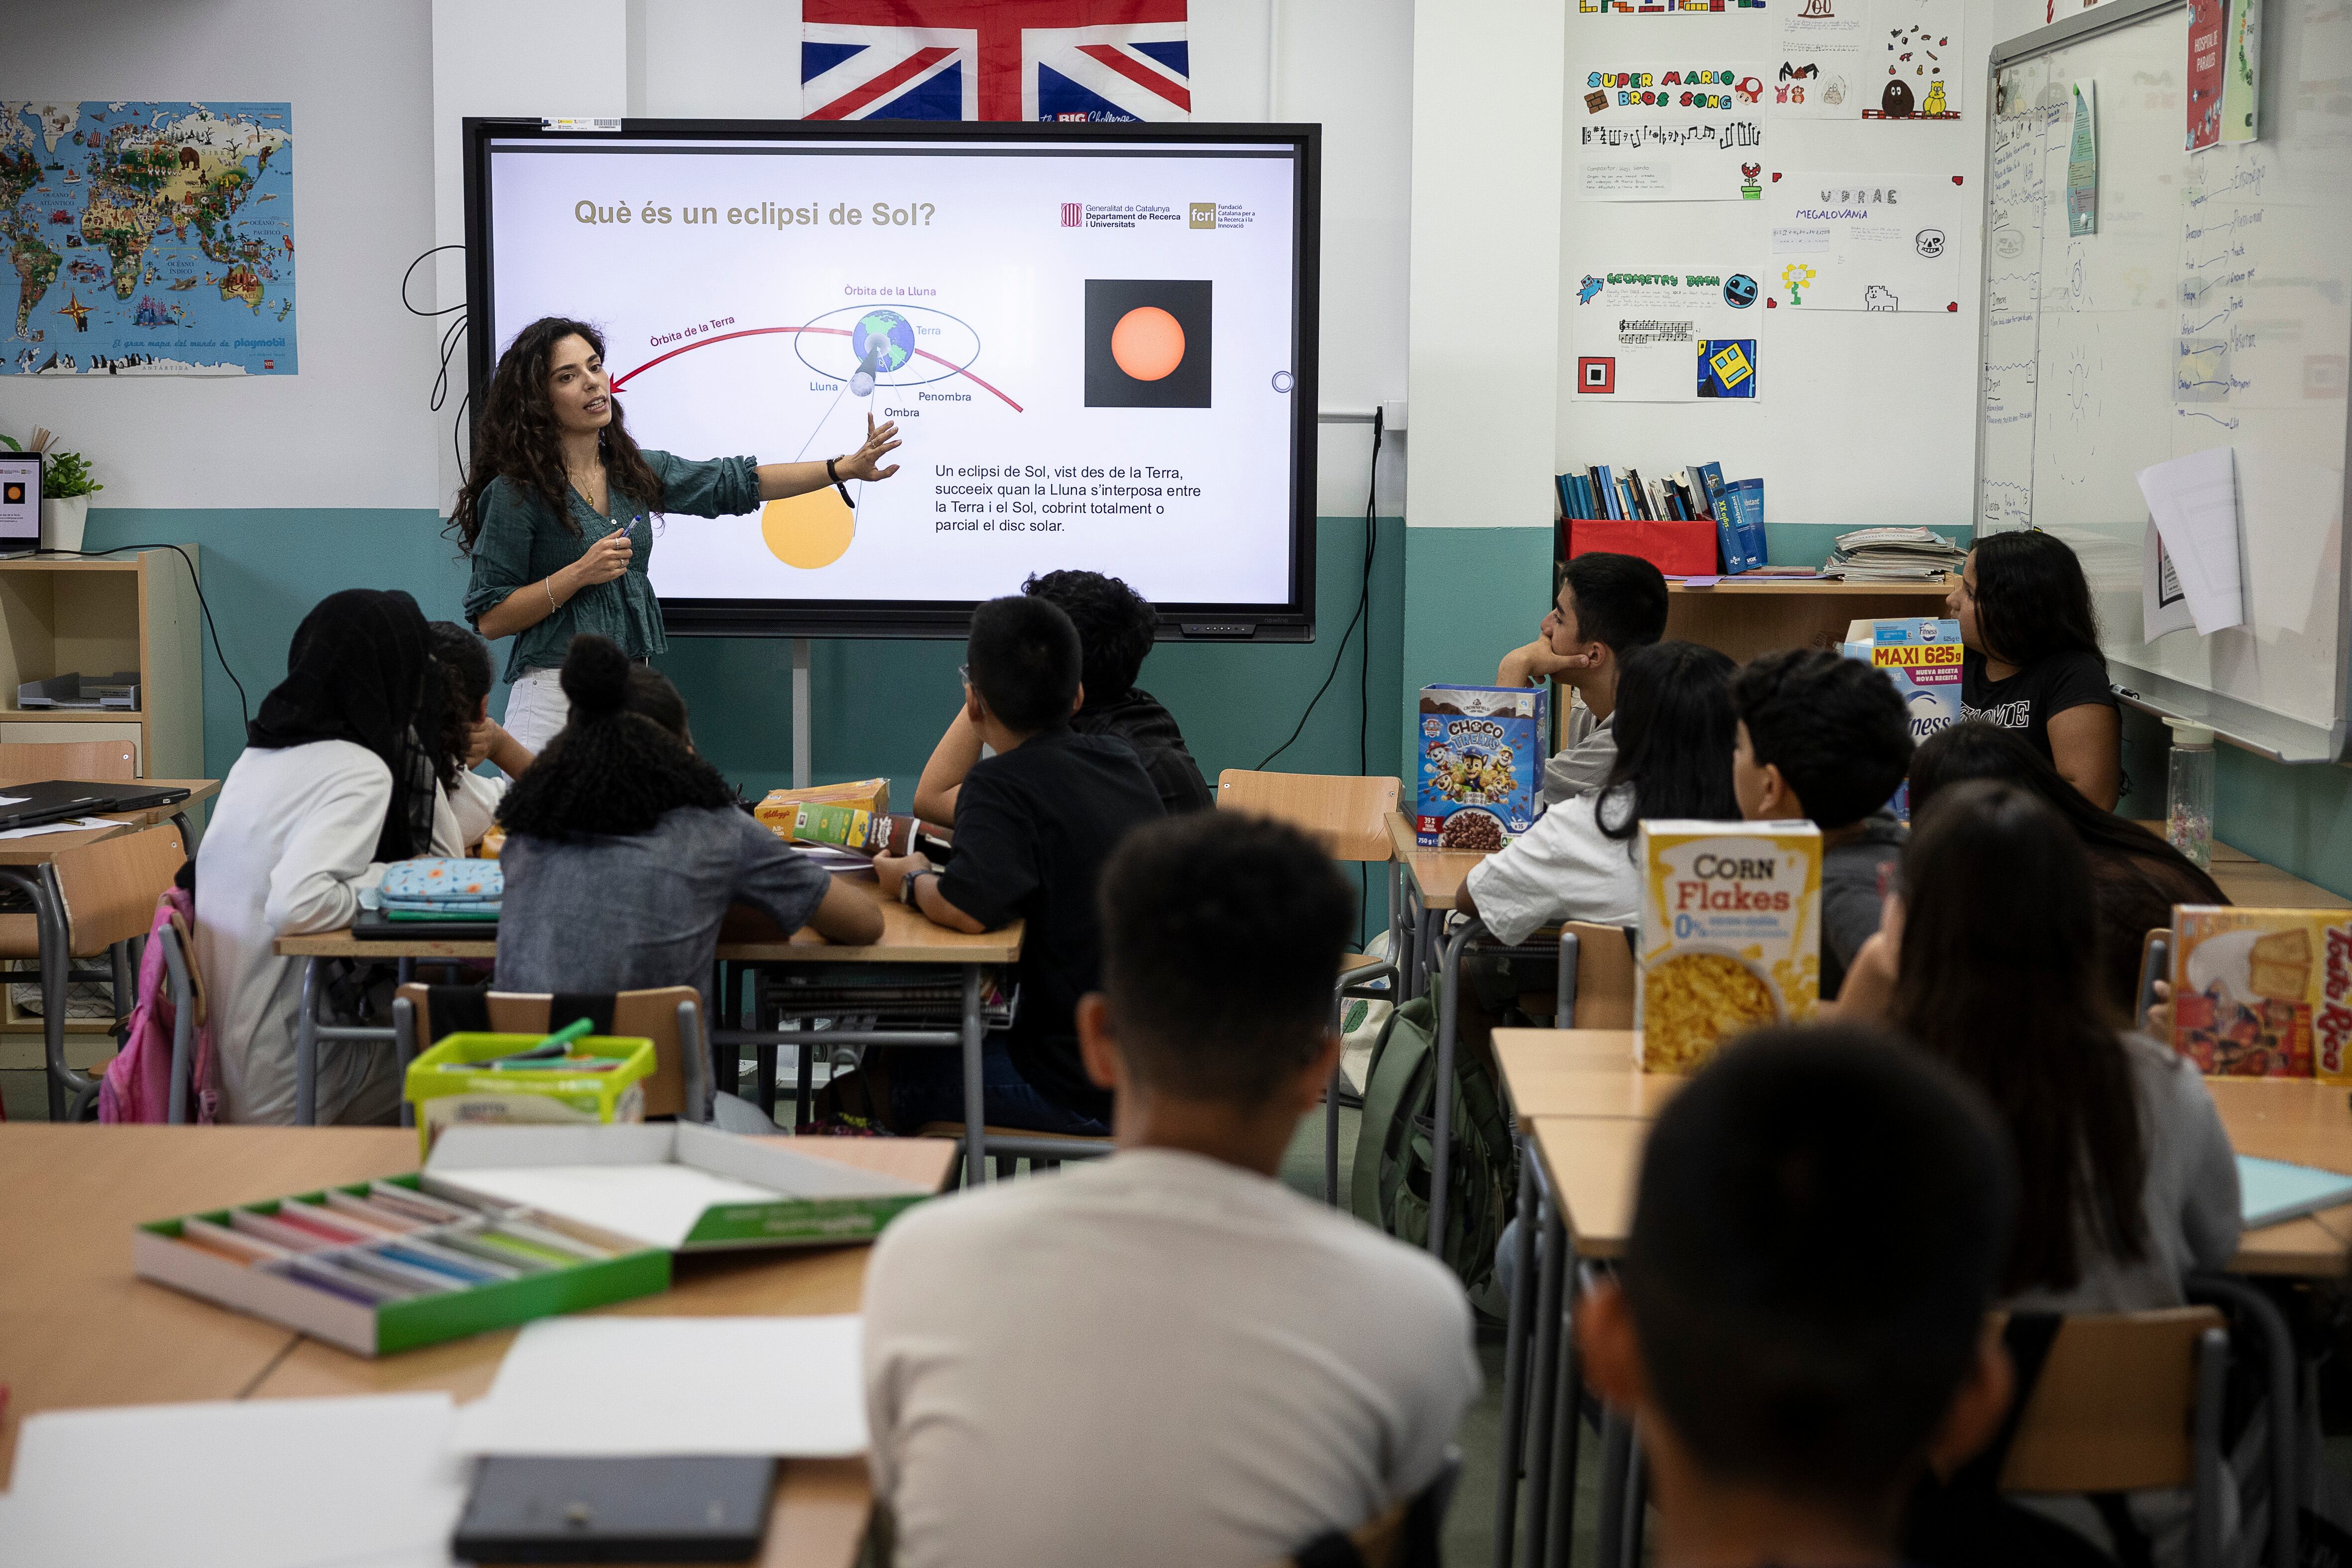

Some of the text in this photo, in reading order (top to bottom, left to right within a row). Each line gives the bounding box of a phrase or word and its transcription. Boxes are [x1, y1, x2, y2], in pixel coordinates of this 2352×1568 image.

[2194, 32, 2213, 53] HOSPITAL
[2197, 52, 2216, 72] PARAULES
[1587, 70, 1735, 89] SUPER MARIO
[1618, 91, 1732, 110] BROS SONG
[1059, 114, 1085, 122] BIG
[1821, 189, 1897, 204] UNDERTALE
[575, 200, 936, 230] Què és un eclipsi de Sol?
[1191, 208, 1214, 222] fcri
[1607, 273, 1720, 287] GEOMETRY DASH
[844, 284, 936, 296] Òrbita de la Lluna
[650, 316, 735, 347] Òrbita de la Terra
[917, 326, 941, 335] Terra
[113, 338, 285, 350] El gran mapa del mundo de playmobil
[810, 382, 838, 391] Lluna
[919, 392, 971, 401] Penombra
[884, 408, 920, 417] Ombra
[936, 465, 1183, 481] Un eclipsi de Sol, vist des de la Terra,
[935, 483, 1201, 498] succeeix quan la Lluna s’interposa entre
[936, 501, 1165, 515] la Terra i el Sol, cobrint totalment o
[1719, 500, 1729, 528] siglo XX
[1732, 495, 1742, 523] Débutant
[936, 519, 1064, 534] parcial el disc solar.
[1919, 626, 1937, 635] Fitness
[1875, 647, 1919, 665] MAXI
[1448, 721, 1504, 739] CHOCO
[1910, 717, 1951, 735] ness
[1451, 733, 1500, 749] TREATS
[763, 810, 790, 819] Kellogg's
[1676, 881, 1791, 912] Flakes
[1675, 914, 1708, 939] 0%
